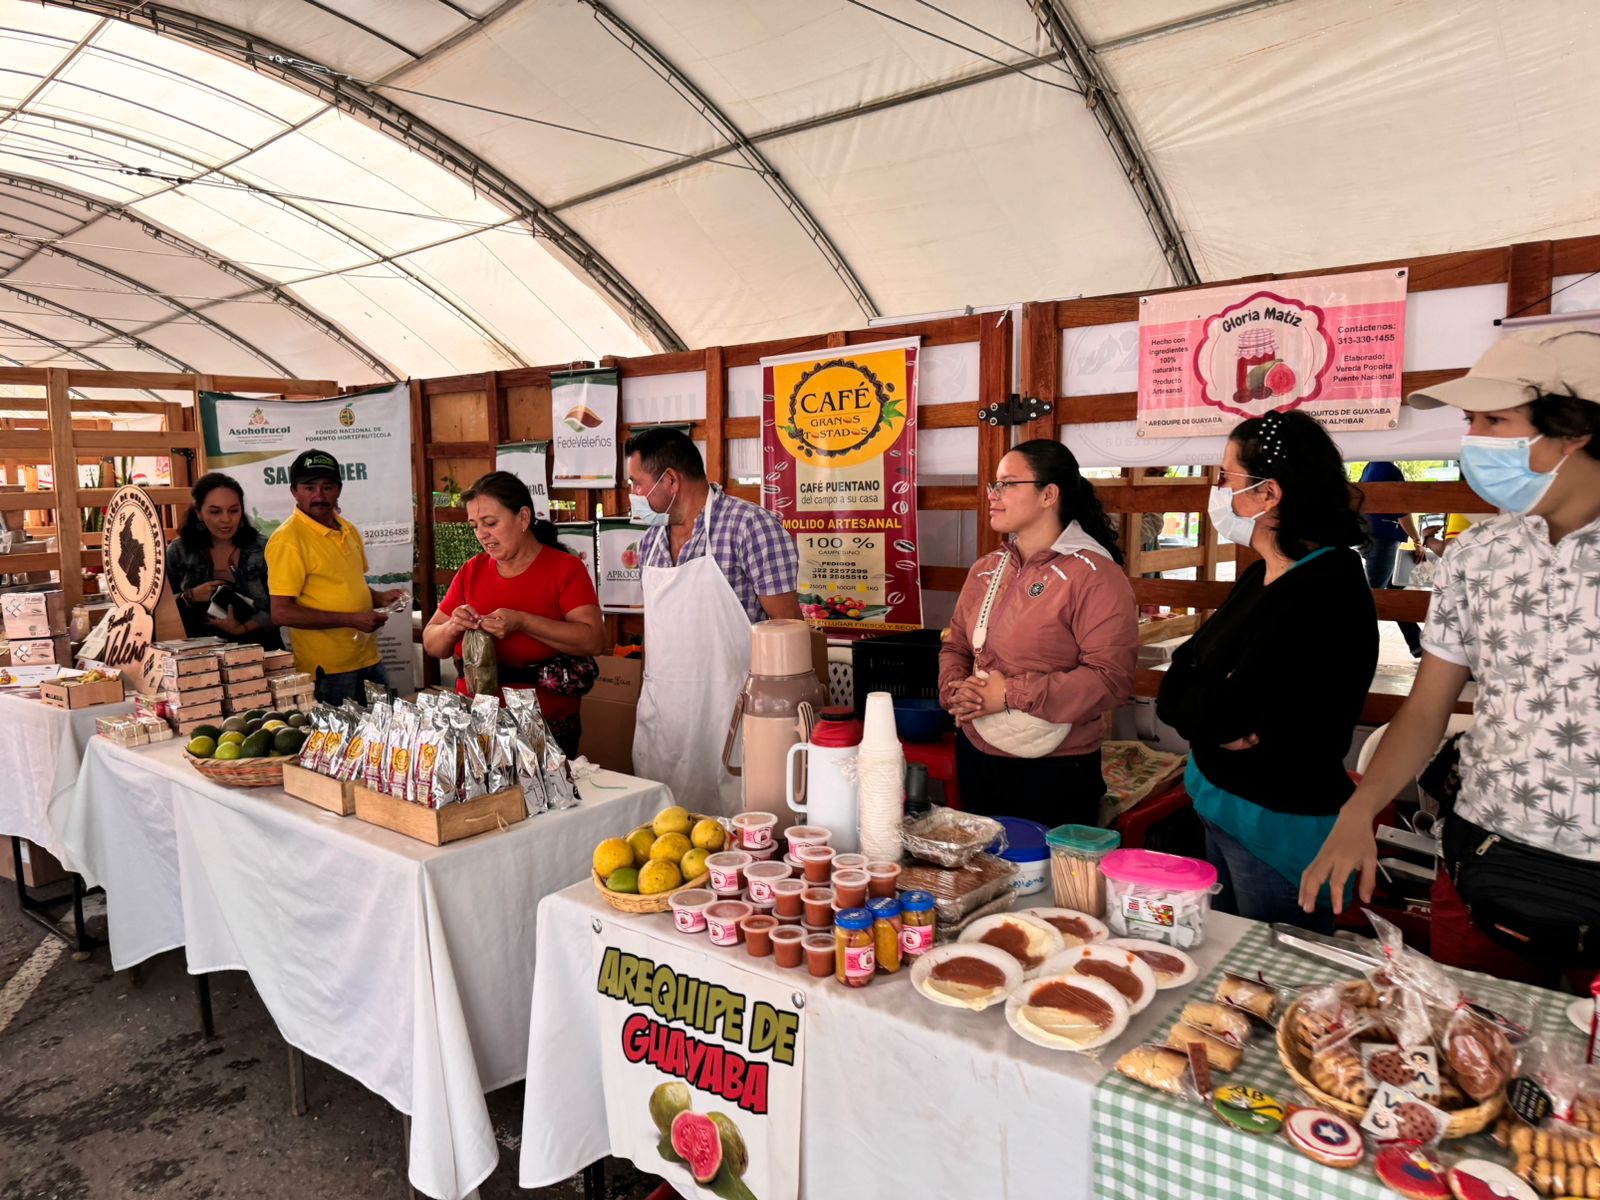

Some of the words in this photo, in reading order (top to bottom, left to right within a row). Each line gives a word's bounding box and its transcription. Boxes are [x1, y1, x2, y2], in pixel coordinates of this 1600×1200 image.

[1222, 310, 1260, 333] Gloria
[1264, 307, 1303, 327] Matiz
[1337, 323, 1396, 334] Contáctenos:
[1337, 334, 1395, 345] 313-330-1455
[1343, 354, 1385, 362] Elaborado:
[1336, 365, 1361, 373] Vereda
[1333, 374, 1359, 382] Puente
[1361, 373, 1394, 381] Nacional
[801, 382, 871, 414] CAFÉ
[1353, 408, 1391, 416] GUAYABA
[1148, 418, 1181, 426] AREQUIPE
[1191, 417, 1222, 425] GUAYABA
[229, 426, 290, 436] Asohofrucol
[557, 434, 612, 448] FedeVeleños
[800, 481, 823, 493] CAFÉ
[826, 480, 880, 492] PUENTANO
[801, 495, 813, 505] del
[815, 497, 838, 507] campo
[859, 494, 879, 503] casa
[782, 519, 825, 530] MOLIDO
[828, 518, 902, 529] ARTESANAL
[805, 537, 843, 549] 100
[852, 537, 875, 549] %
[606, 570, 640, 578] APROCO
[598, 946, 746, 1044] AREQUIPE
[748, 1001, 799, 1066] DE
[622, 1013, 769, 1115] GUAYABA
